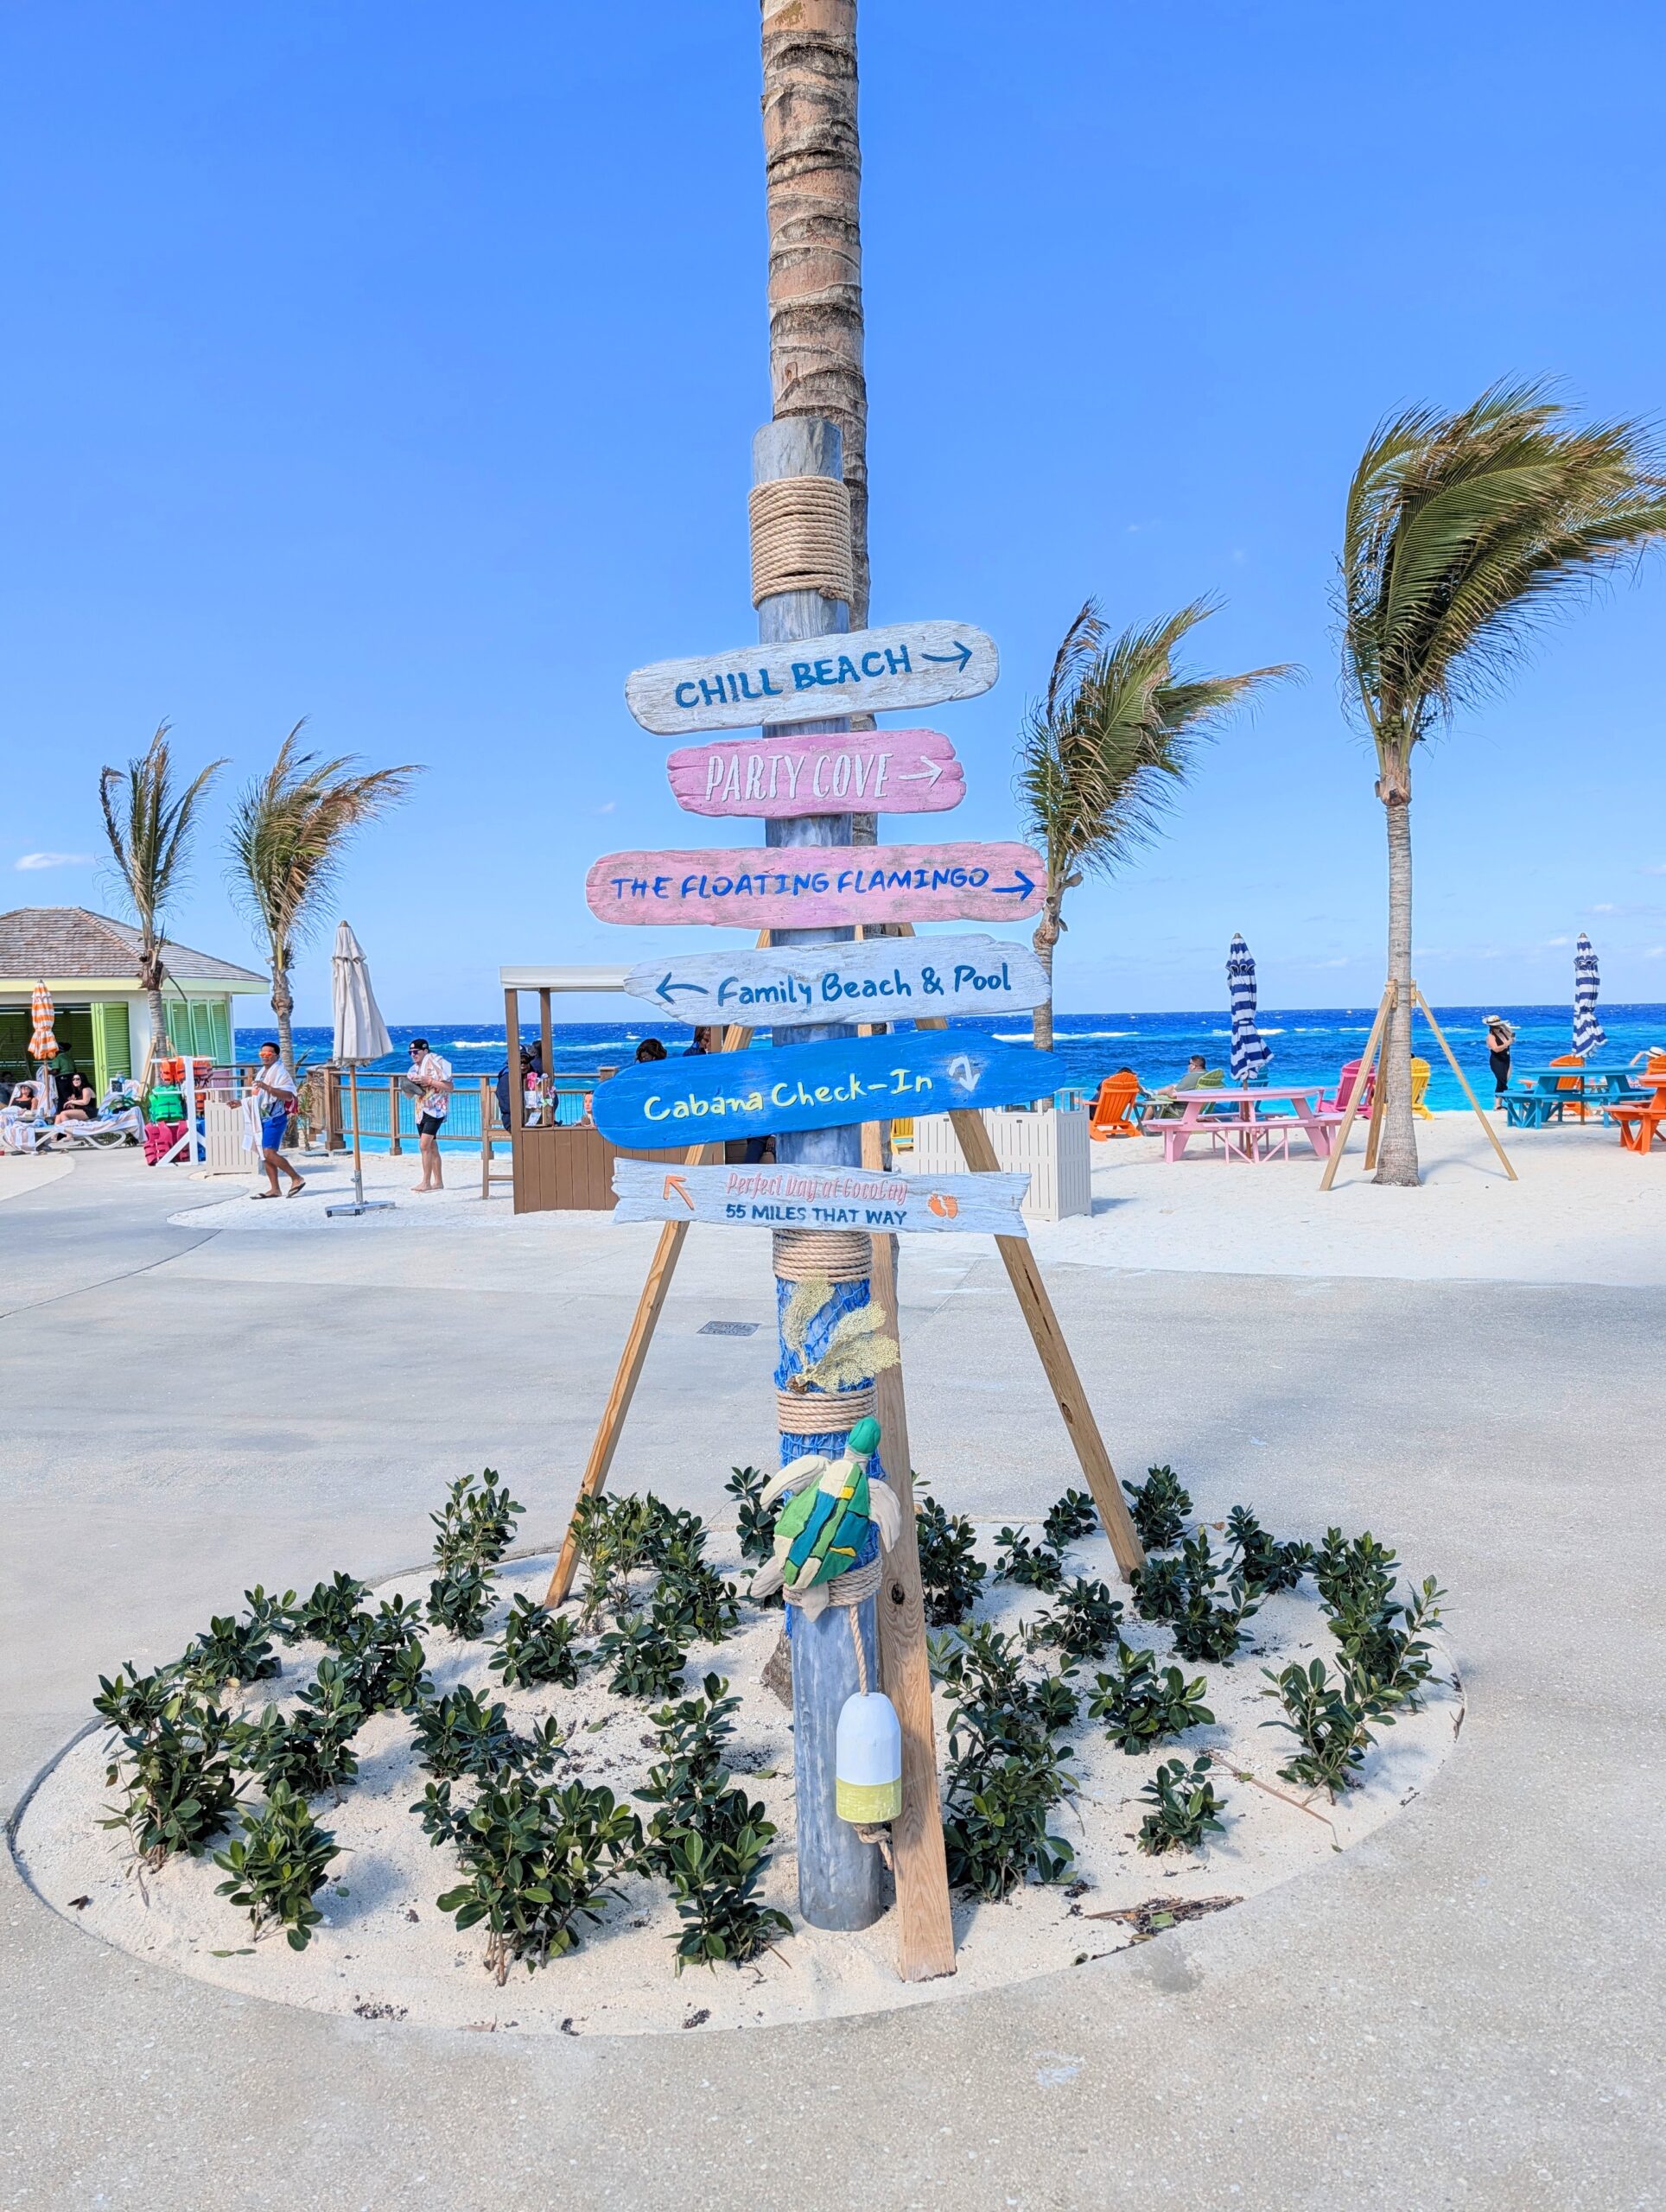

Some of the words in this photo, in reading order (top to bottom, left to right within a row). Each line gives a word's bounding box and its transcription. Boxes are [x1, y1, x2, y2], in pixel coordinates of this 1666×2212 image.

[676, 669, 783, 709] CHILL
[792, 645, 912, 691] BEACH
[705, 753, 805, 802] PARTY
[812, 753, 893, 799] COVE
[611, 876, 674, 899] THE
[681, 872, 830, 899] FLOATING
[837, 868, 989, 895] FLAMINGO
[717, 975, 812, 1007] Family
[822, 969, 912, 1001] Beach
[922, 966, 944, 996] &
[953, 963, 1013, 993] Pool
[644, 1092, 765, 1122] Cabana
[771, 1068, 934, 1108] Check-In
[726, 1171, 783, 1200] Perfect
[785, 1174, 818, 1203] Day
[822, 1178, 839, 1198] at
[842, 1178, 908, 1206] CocoCay
[726, 1203, 747, 1219] 55
[751, 1204, 807, 1221] MILES
[811, 1206, 861, 1224] THAT
[865, 1209, 908, 1226] WAY
